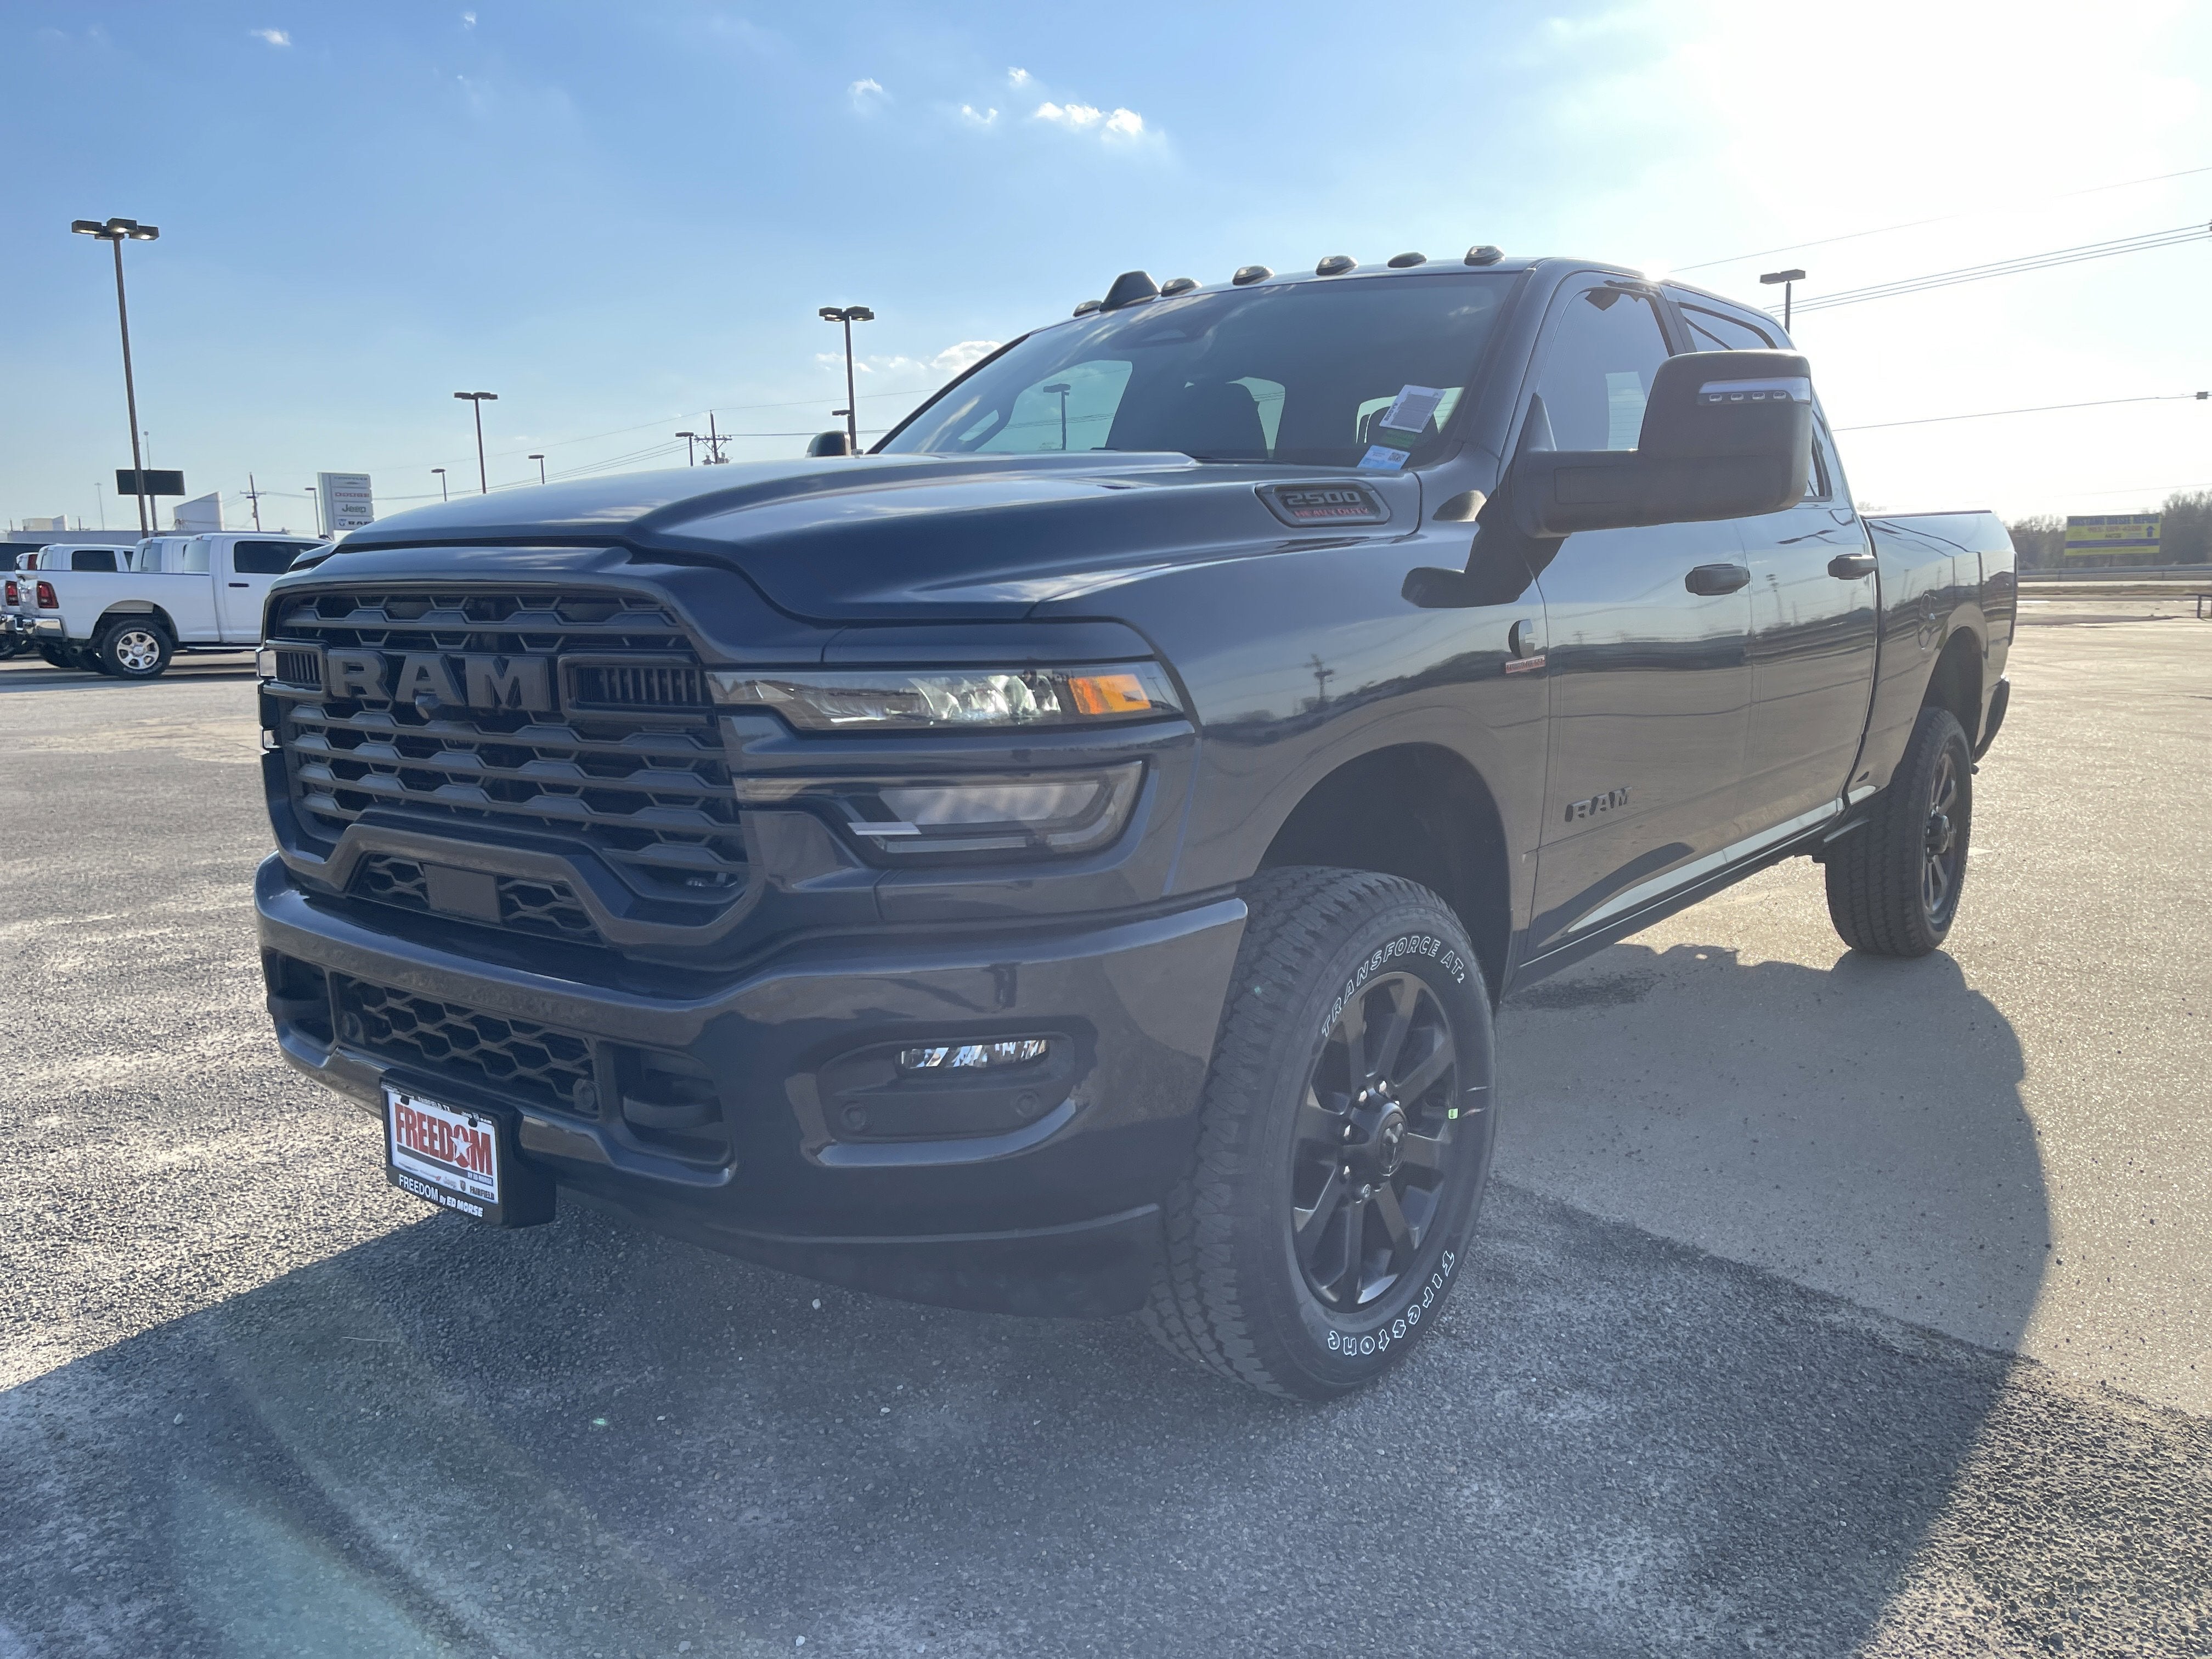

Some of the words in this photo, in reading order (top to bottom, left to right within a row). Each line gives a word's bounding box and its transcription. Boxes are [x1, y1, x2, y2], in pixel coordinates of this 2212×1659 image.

[342, 504, 366, 514] Jeep
[1285, 491, 1361, 506] 2500
[328, 648, 550, 712] RAM
[1565, 786, 1633, 822] RAM
[1321, 935, 1441, 1037] TRANSFORCE
[394, 1102, 493, 1176] FREEDOM
[399, 1173, 439, 1201] FREEDOM
[439, 1195, 447, 1206] by
[447, 1195, 456, 1208] ED
[456, 1199, 484, 1218] MORSE
[1327, 1250, 1455, 1356] Firestone
